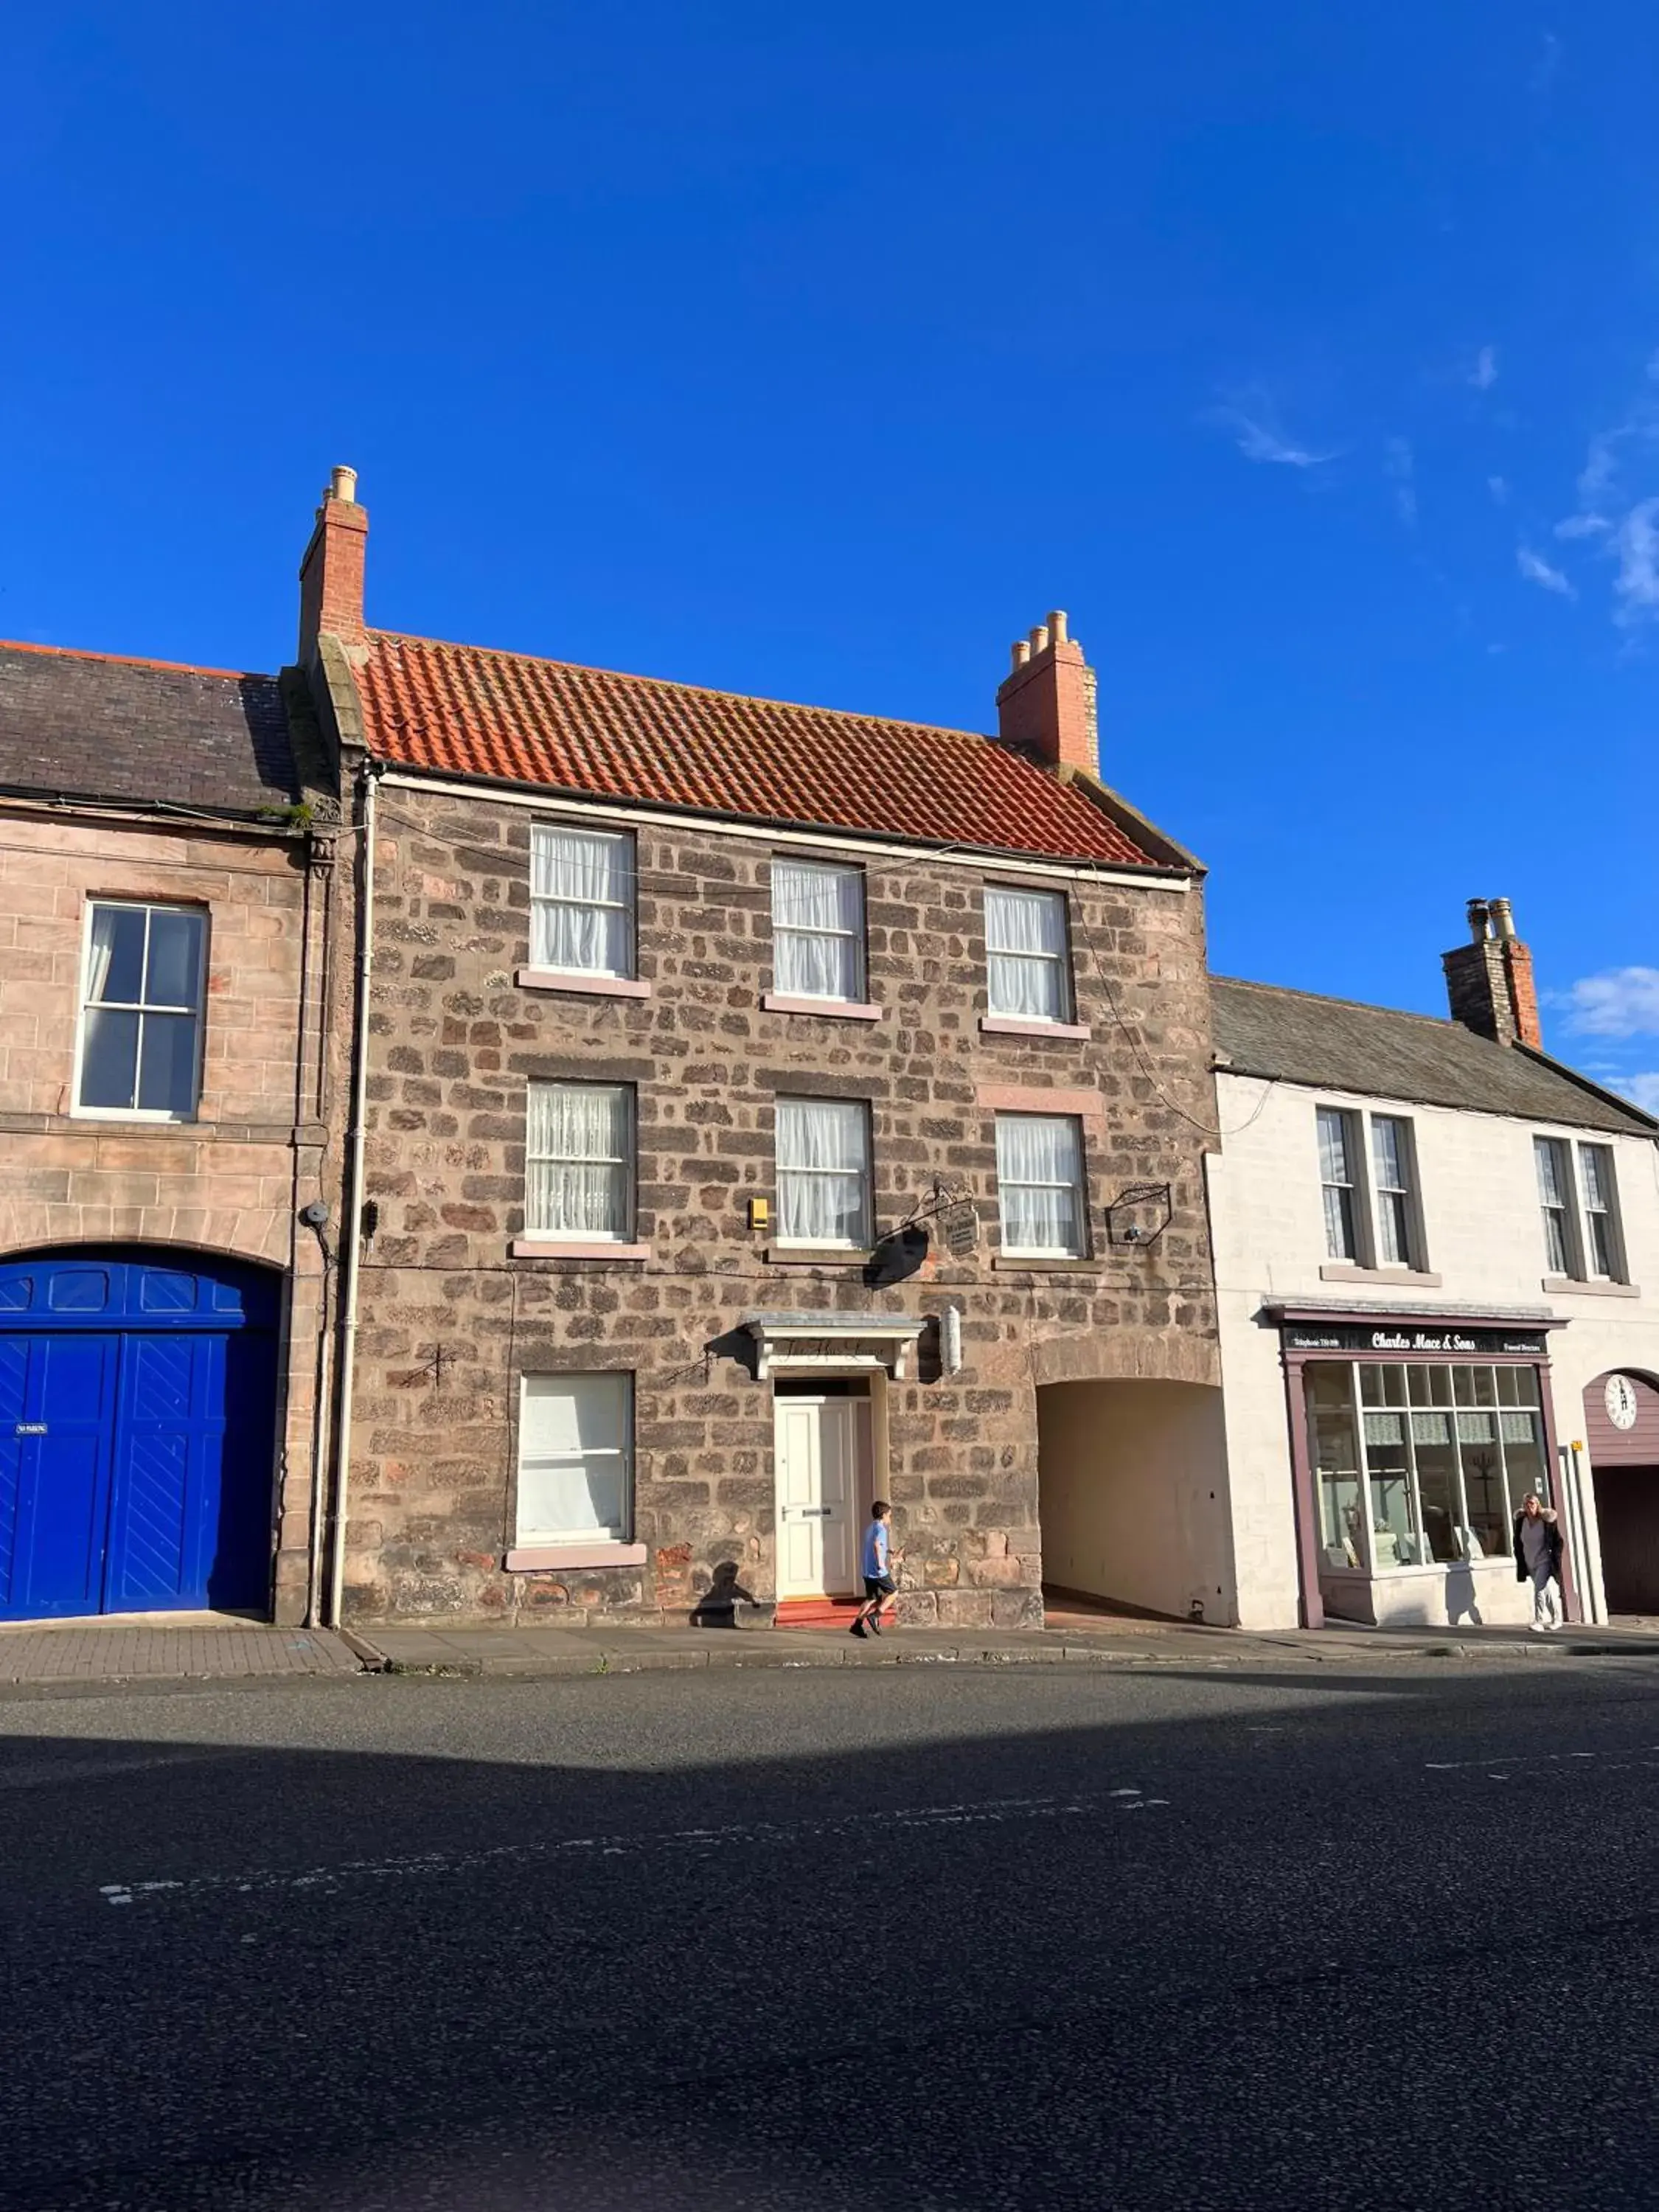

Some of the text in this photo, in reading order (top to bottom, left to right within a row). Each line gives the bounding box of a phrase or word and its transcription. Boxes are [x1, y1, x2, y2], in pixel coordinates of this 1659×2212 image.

[1372, 1332, 1475, 1350] Charles Mace & Sons
